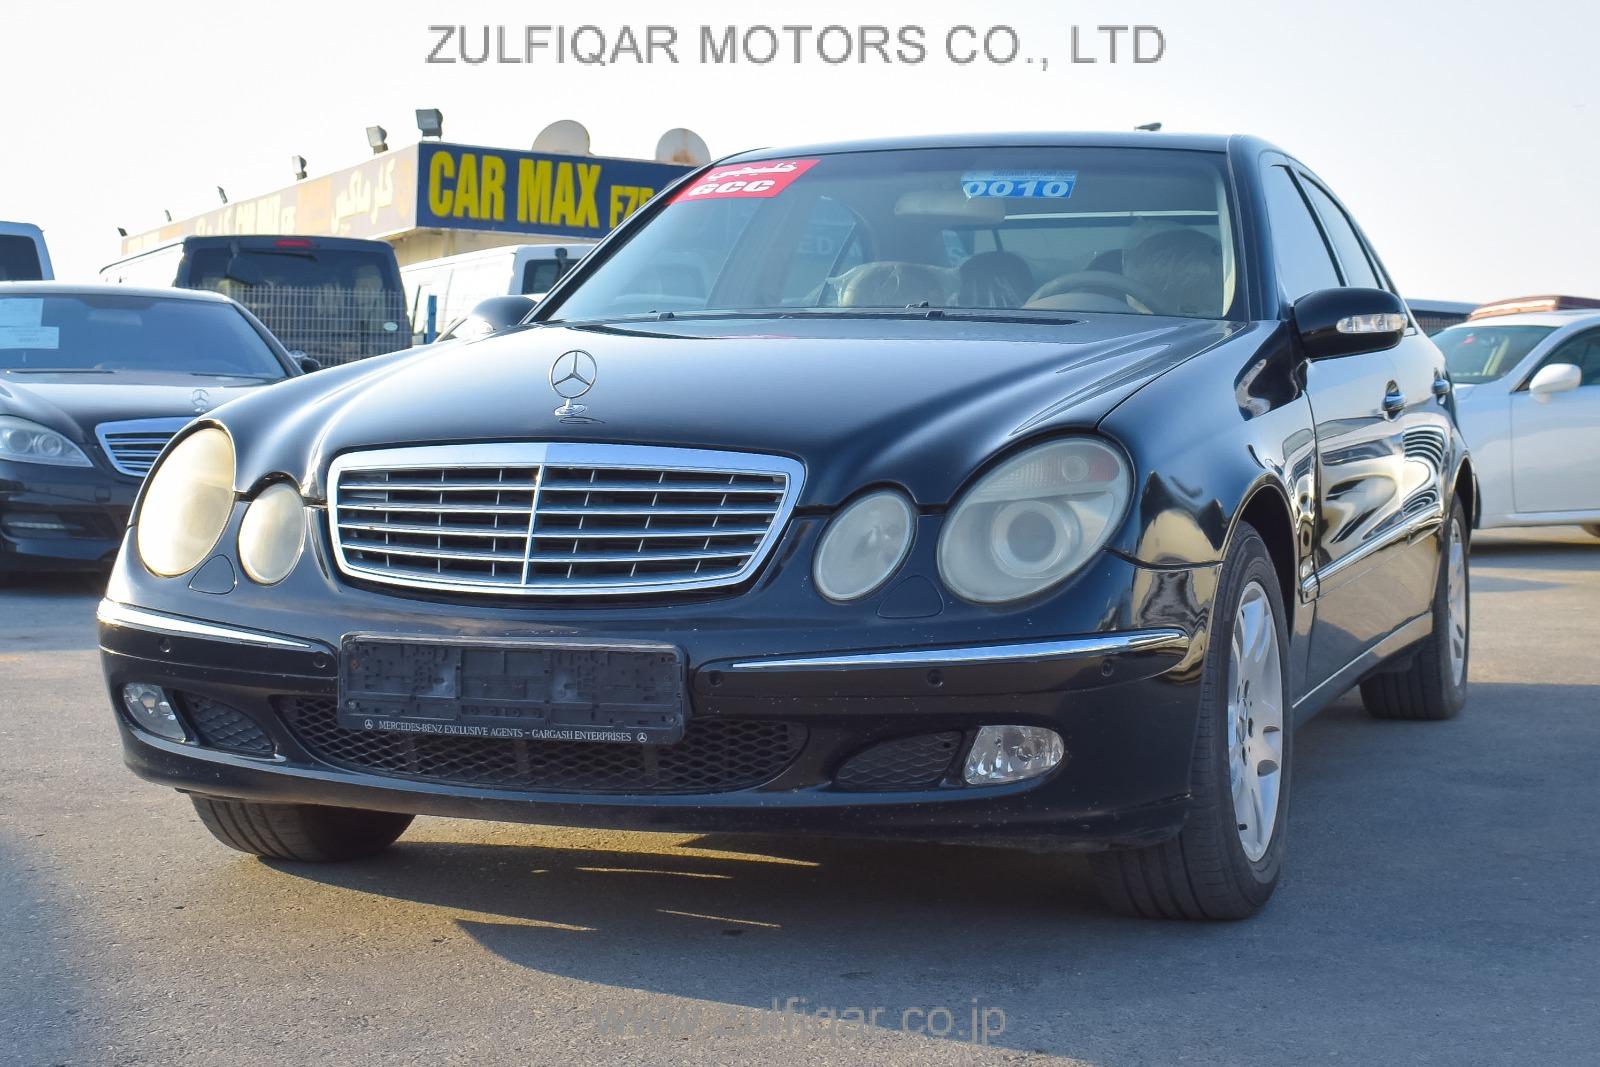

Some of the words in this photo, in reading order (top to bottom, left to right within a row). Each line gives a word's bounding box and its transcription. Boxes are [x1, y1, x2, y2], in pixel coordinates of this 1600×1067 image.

[428, 151, 506, 221] CAR
[517, 158, 602, 228] MAX
[688, 180, 776, 196] GCC
[963, 181, 1069, 198] 0010
[379, 721, 443, 734] MERCEDES-BENZ
[444, 725, 489, 736] EXCLUSIVE
[490, 728, 523, 738] AGENTS
[531, 729, 573, 740] GARGASH
[574, 731, 632, 742] ENTERPRISES
